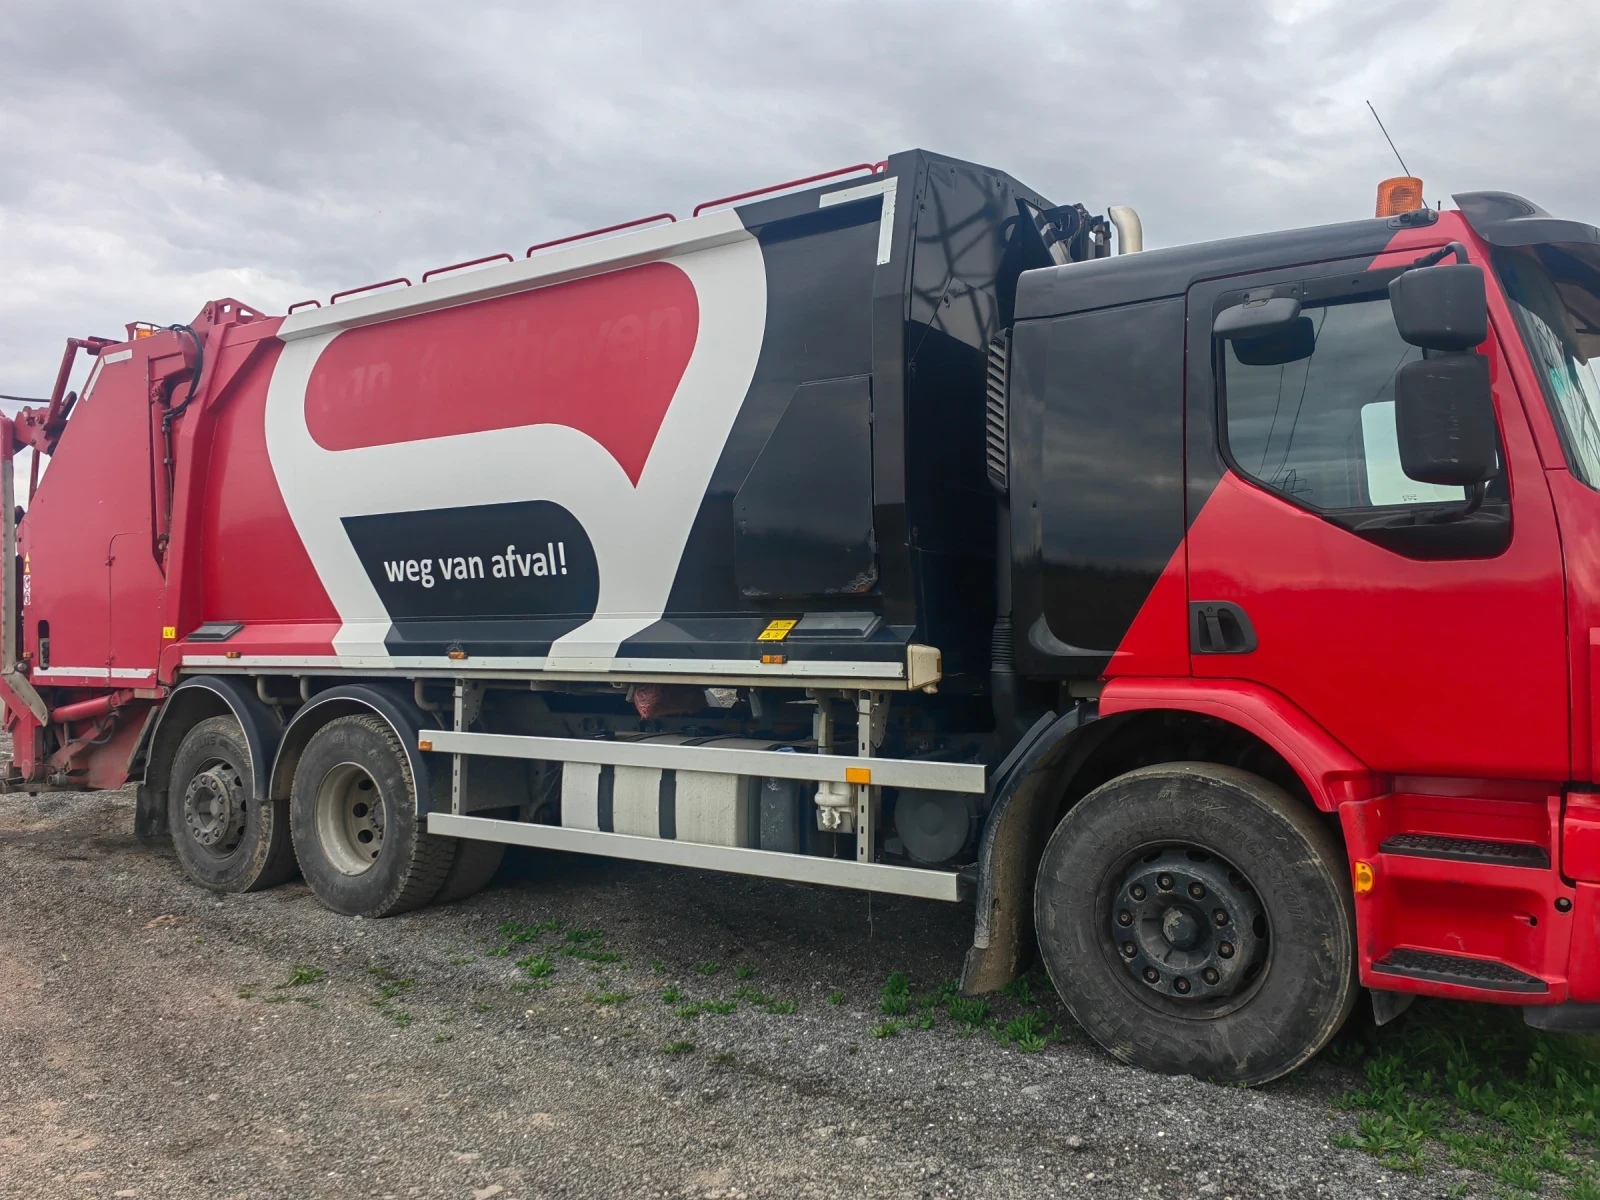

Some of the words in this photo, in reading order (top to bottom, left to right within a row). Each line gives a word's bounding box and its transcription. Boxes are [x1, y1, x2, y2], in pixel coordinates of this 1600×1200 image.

[383, 558, 435, 588] weg
[438, 555, 485, 580] van
[491, 541, 568, 578] afval!
